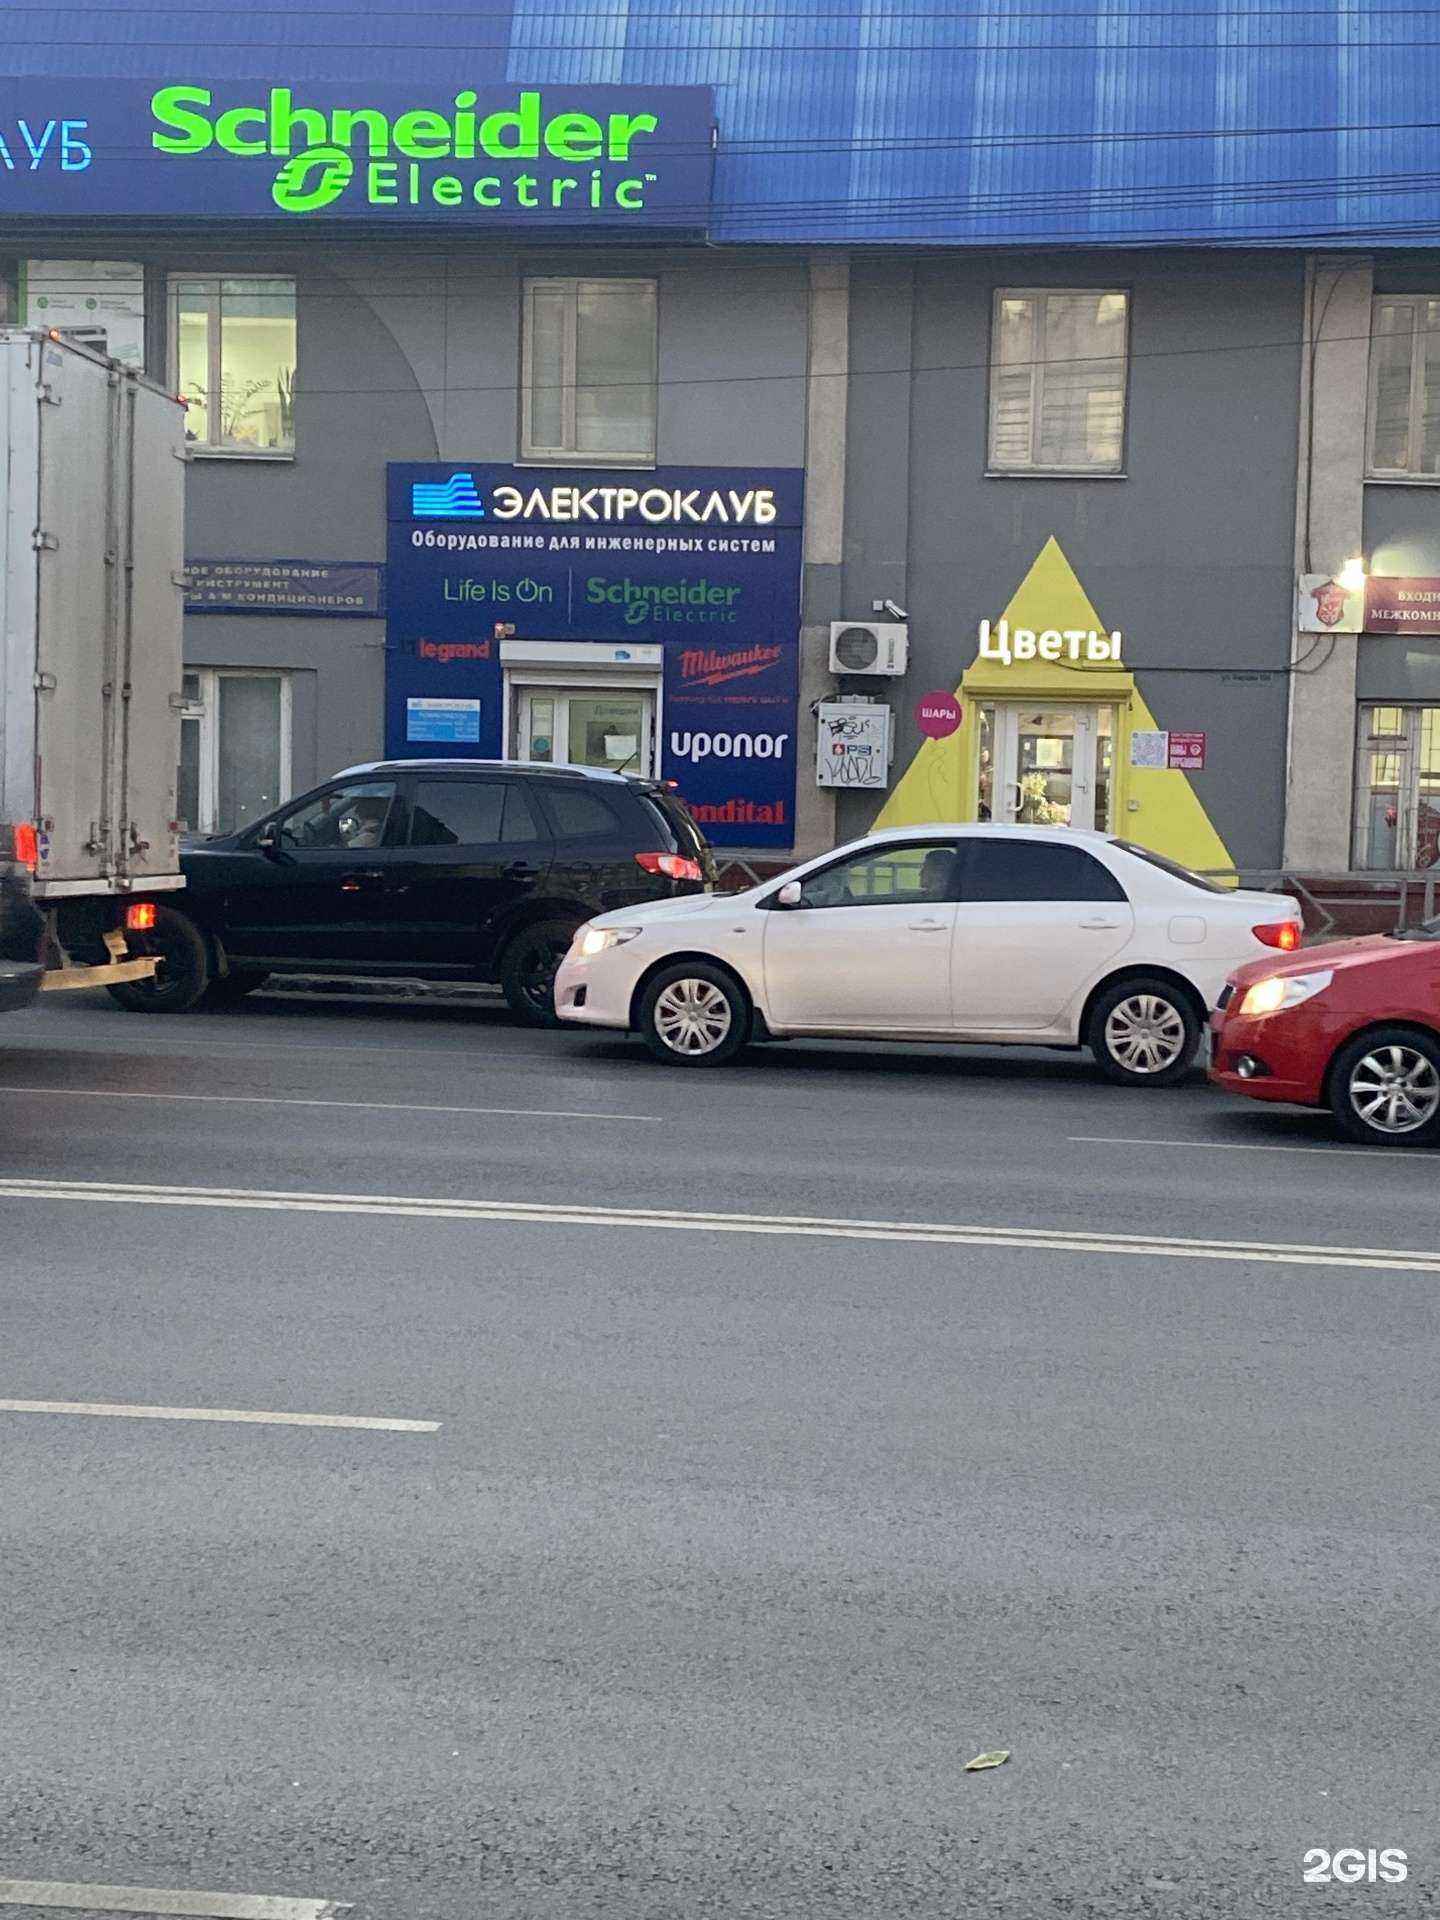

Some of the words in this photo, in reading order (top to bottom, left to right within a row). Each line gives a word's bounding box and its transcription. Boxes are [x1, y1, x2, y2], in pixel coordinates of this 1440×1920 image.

[150, 84, 658, 162] Schneider
[492, 486, 778, 524] ЭЛЕКТРОКЛУБ
[411, 529, 545, 551] Оборудование
[549, 536, 581, 551] для
[585, 536, 704, 554] инженерных
[707, 538, 776, 553] систем
[196, 579, 290, 590] ИНСТРУМЕНТ
[215, 566, 329, 578] ОБОРУДОВАНИЕ
[238, 592, 364, 606] КОНДИЦИОНЕРОВ
[444, 579, 486, 601] Life
[492, 580, 511, 602] Is
[516, 577, 553, 602] On
[585, 577, 742, 605] Schneider
[653, 605, 737, 623] Electric
[420, 637, 490, 663] legrand
[979, 618, 1122, 666] Цветы
[921, 707, 957, 721] ШАРЫ
[671, 732, 788, 763] uponor
